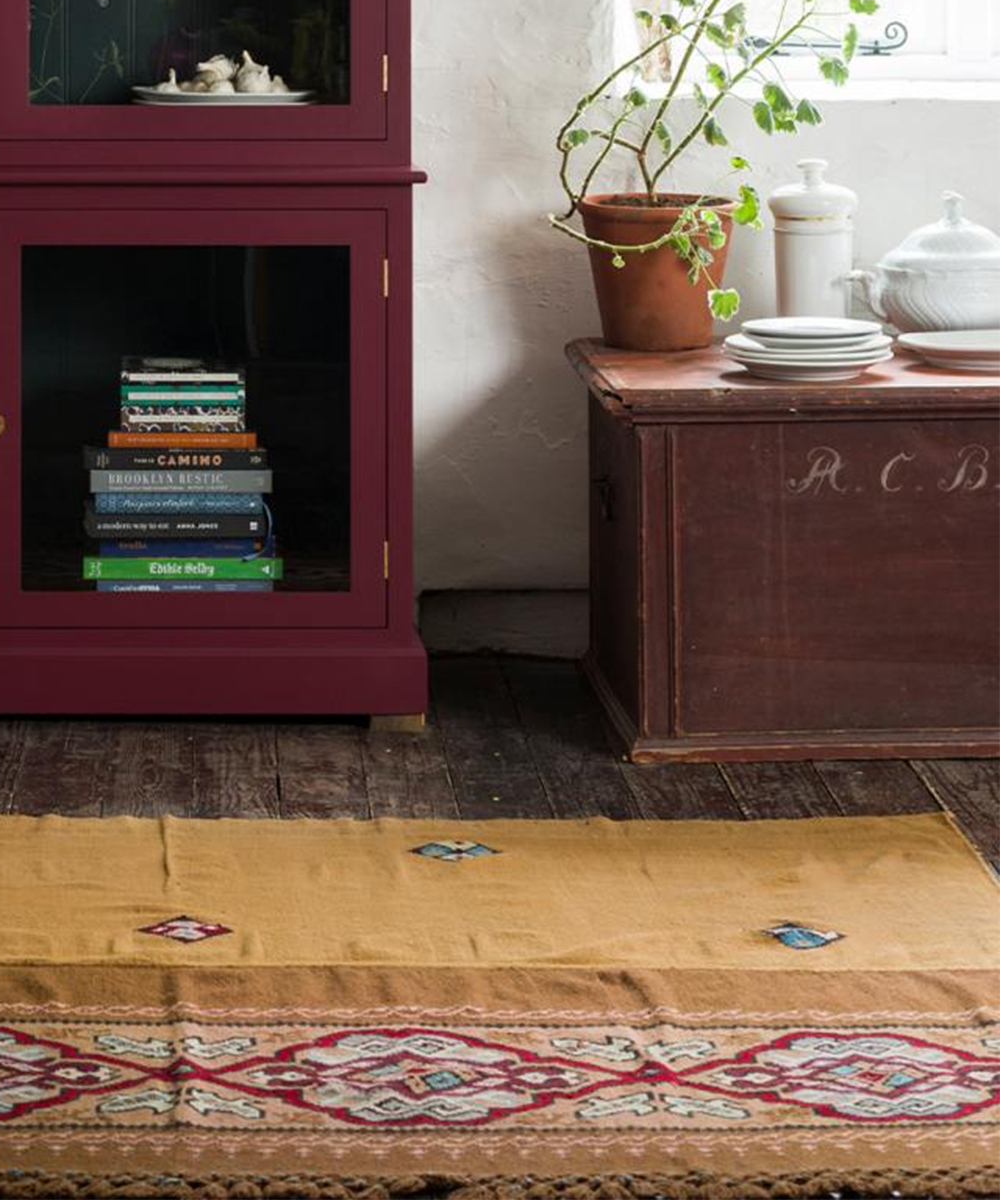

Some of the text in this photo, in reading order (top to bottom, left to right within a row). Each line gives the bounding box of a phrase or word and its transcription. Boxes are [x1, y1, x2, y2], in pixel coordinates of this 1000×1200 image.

[157, 454, 222, 466] CAMINO
[108, 473, 223, 485] BROOKLYN RUSTIC
[148, 562, 215, 577] Edible Selby
